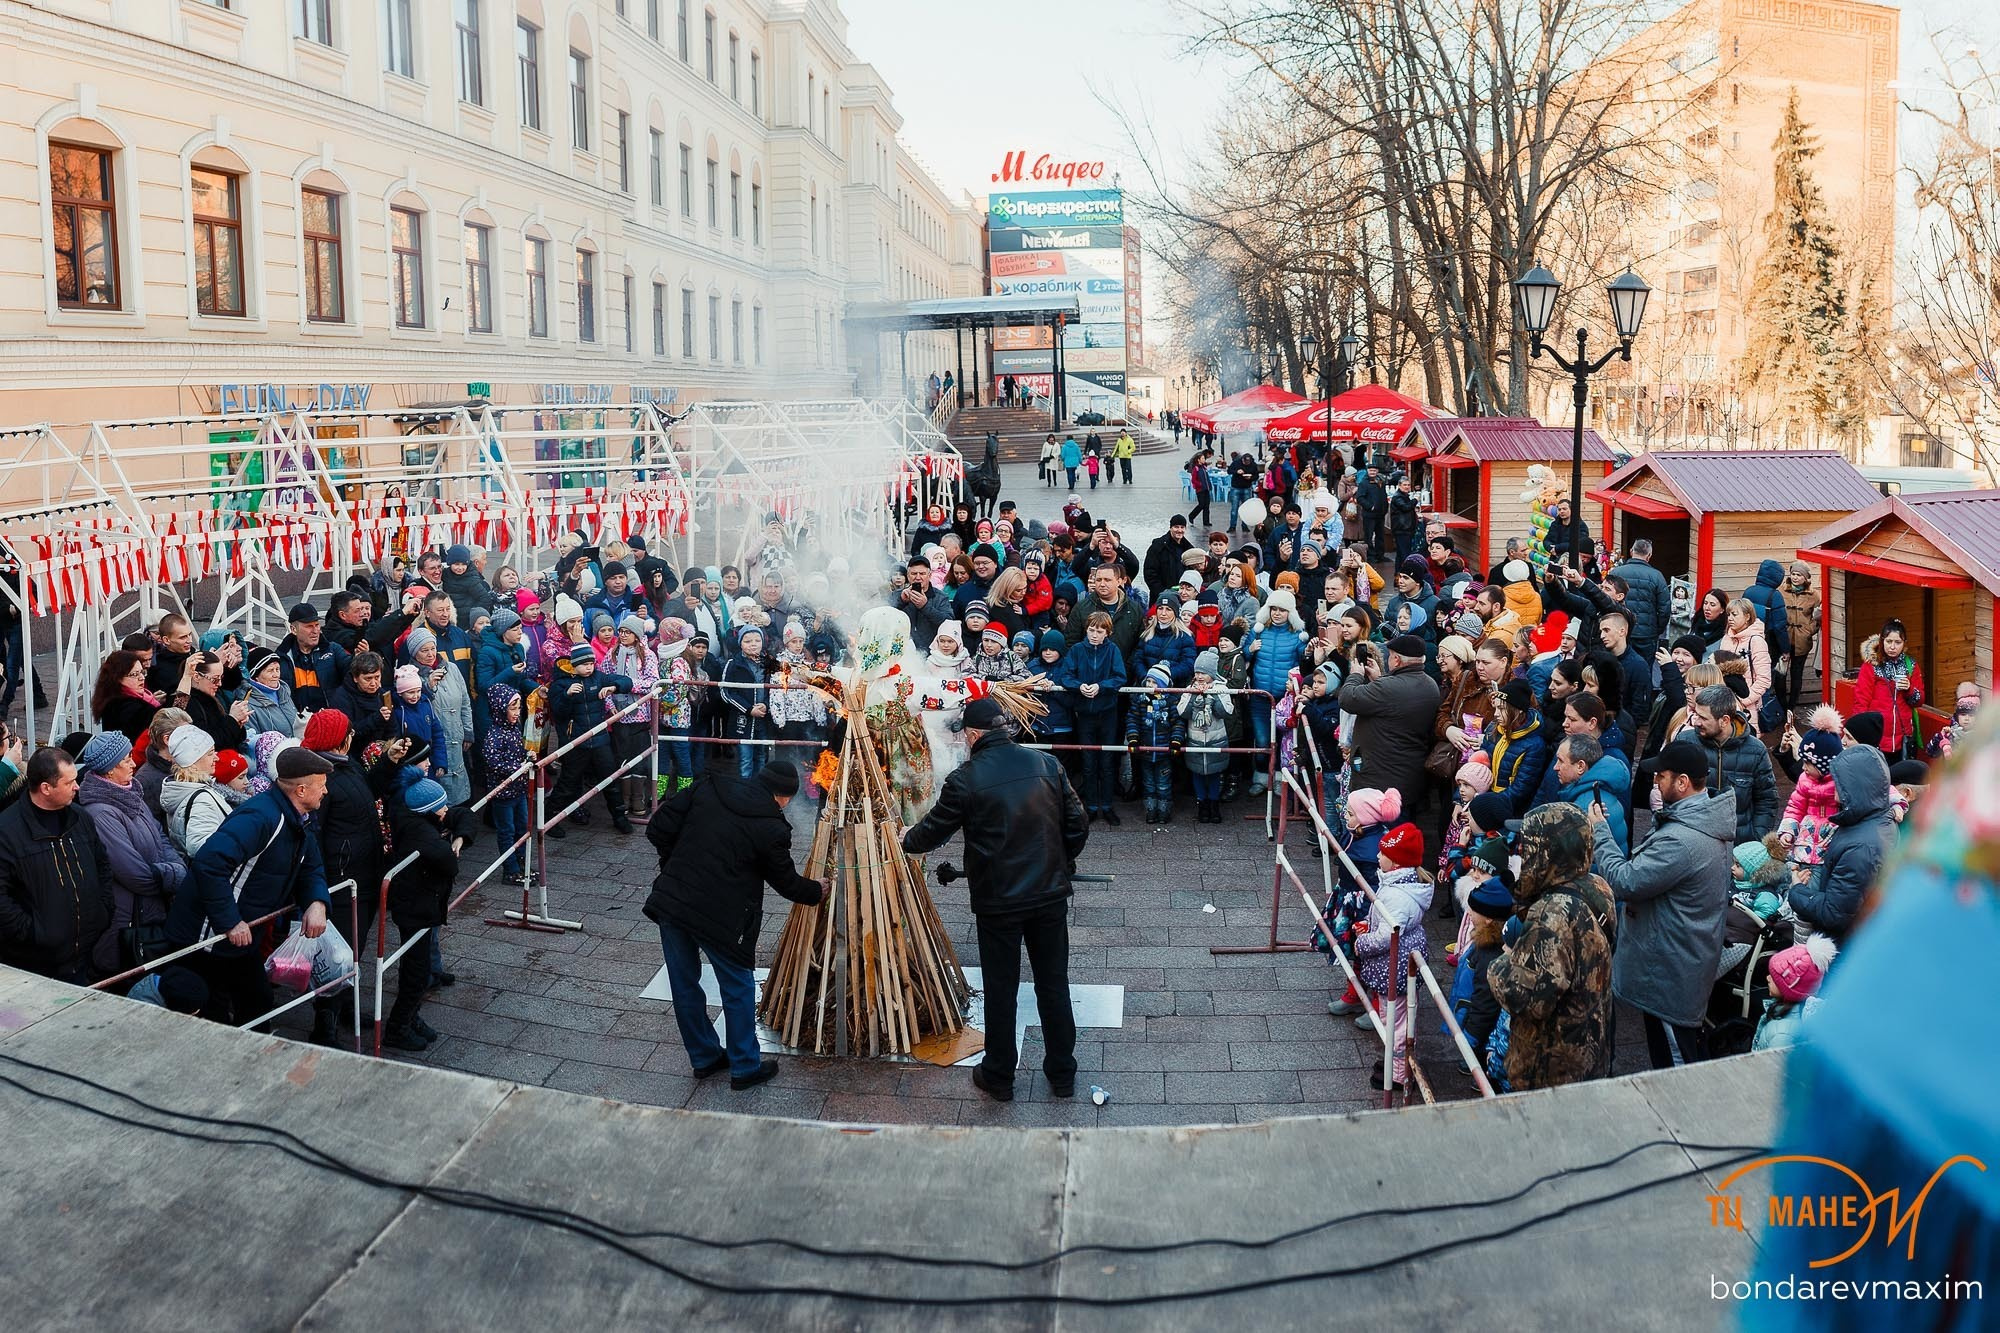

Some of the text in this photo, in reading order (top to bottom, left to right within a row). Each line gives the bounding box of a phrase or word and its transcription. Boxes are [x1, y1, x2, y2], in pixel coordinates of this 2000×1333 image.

[991, 150, 1104, 187] М.видео
[1012, 279, 1082, 295] кораблик
[1094, 281, 1101, 291] 2
[998, 328, 1032, 339] DNS
[1096, 374, 1124, 382] MANGO
[220, 384, 371, 415] FUN DAY
